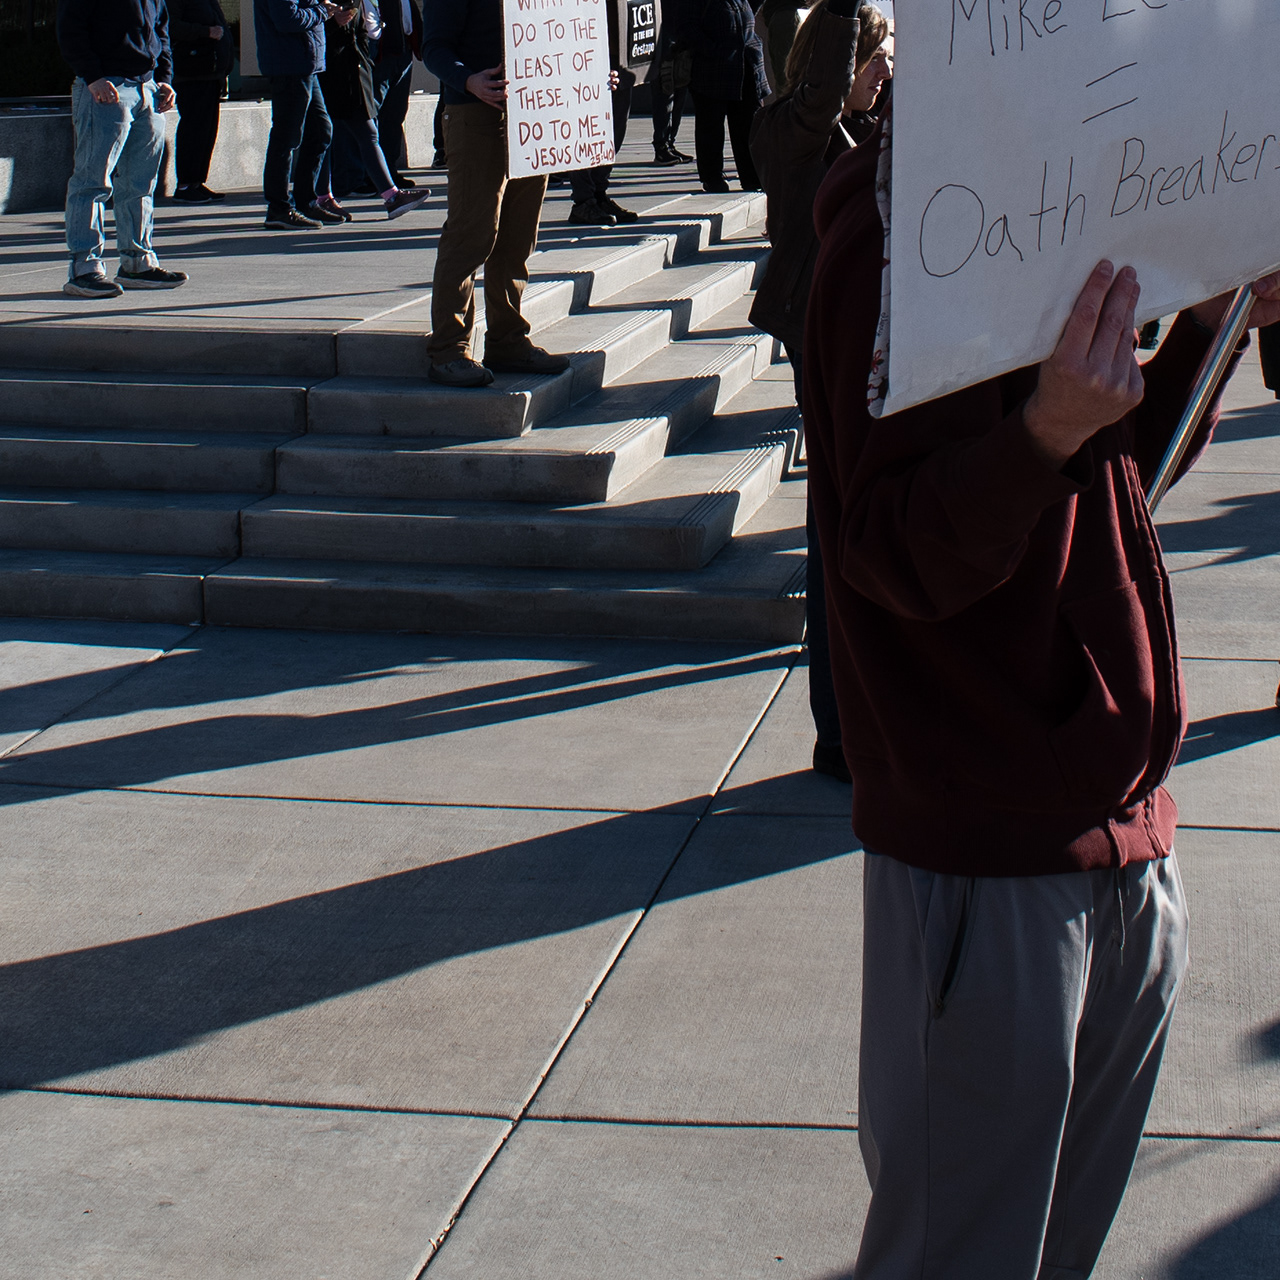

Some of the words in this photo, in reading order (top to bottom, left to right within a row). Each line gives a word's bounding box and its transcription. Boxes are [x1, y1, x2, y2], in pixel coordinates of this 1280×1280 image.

[631, 3, 654, 29] ICE
[511, 22, 537, 48] DO
[543, 19, 565, 42] TO
[569, 18, 598, 41] THE
[514, 52, 564, 80] LEAST
[572, 49, 595, 72] OF
[514, 85, 569, 110] THESE,
[572, 82, 601, 105] YOU
[519, 121, 543, 147] DO
[549, 119, 572, 141] TO
[918, 154, 1087, 279] Oath
